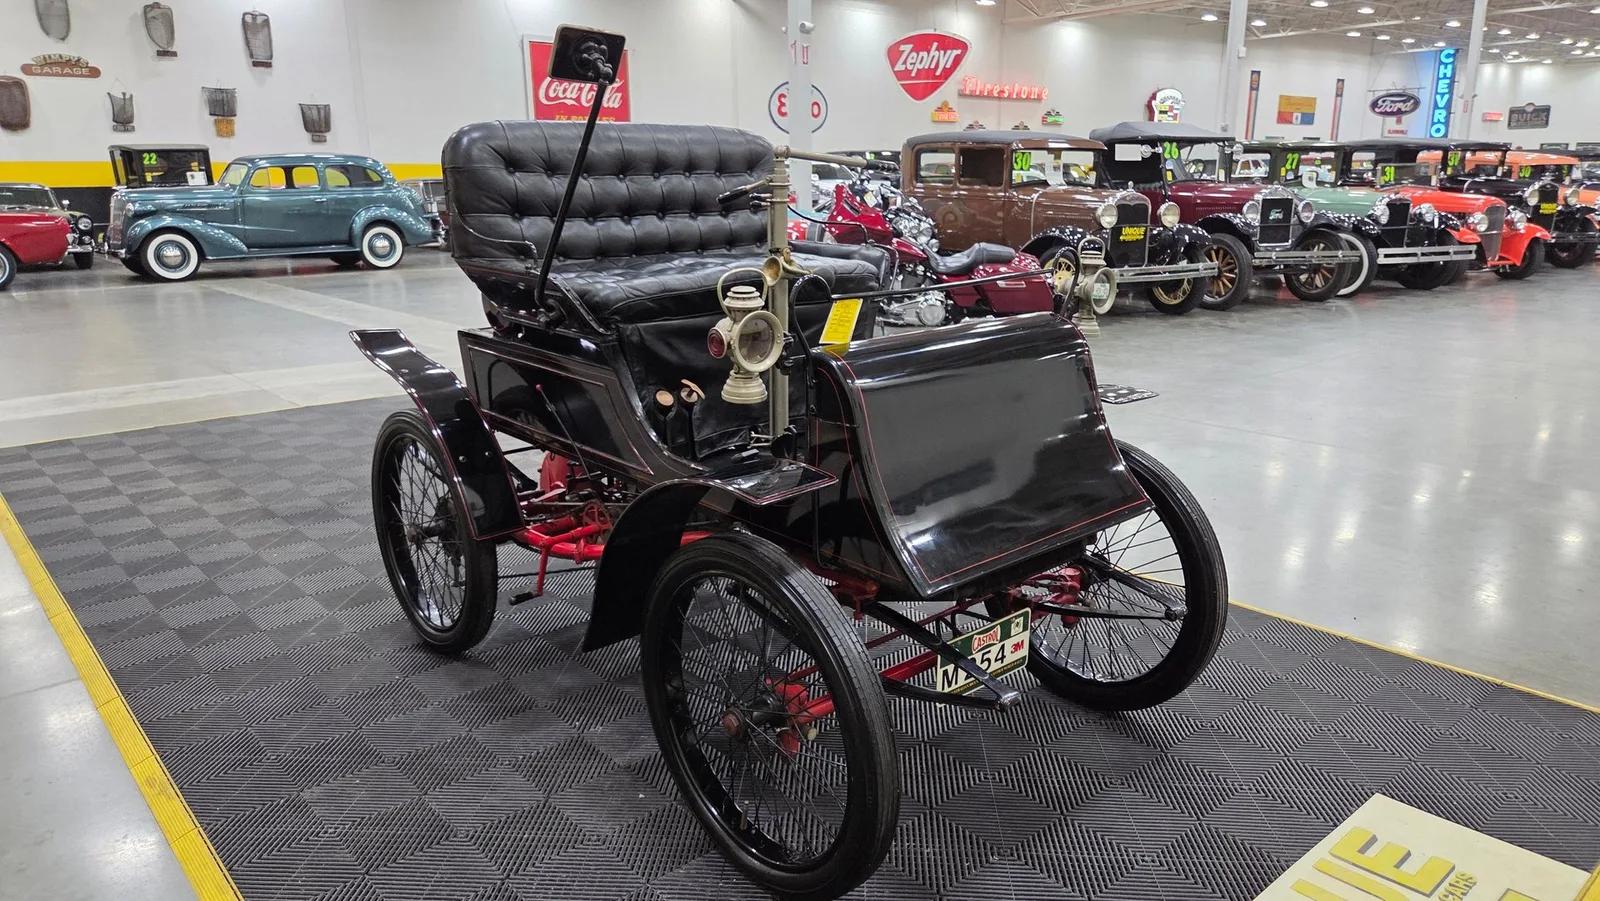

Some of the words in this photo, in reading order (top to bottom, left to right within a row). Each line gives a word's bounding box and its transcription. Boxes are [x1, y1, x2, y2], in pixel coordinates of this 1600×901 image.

[895, 42, 961, 77] Zephyr
[32, 66, 91, 76] GARAGE
[964, 76, 1049, 99] Firestone
[1430, 49, 1457, 138] CHEVRO
[1375, 97, 1414, 114] Ford
[143, 152, 157, 165] 22
[1163, 141, 1180, 159] 26
[1013, 151, 1031, 171] 30
[1285, 152, 1300, 170] 27
[1011, 640, 1024, 654] 3M
